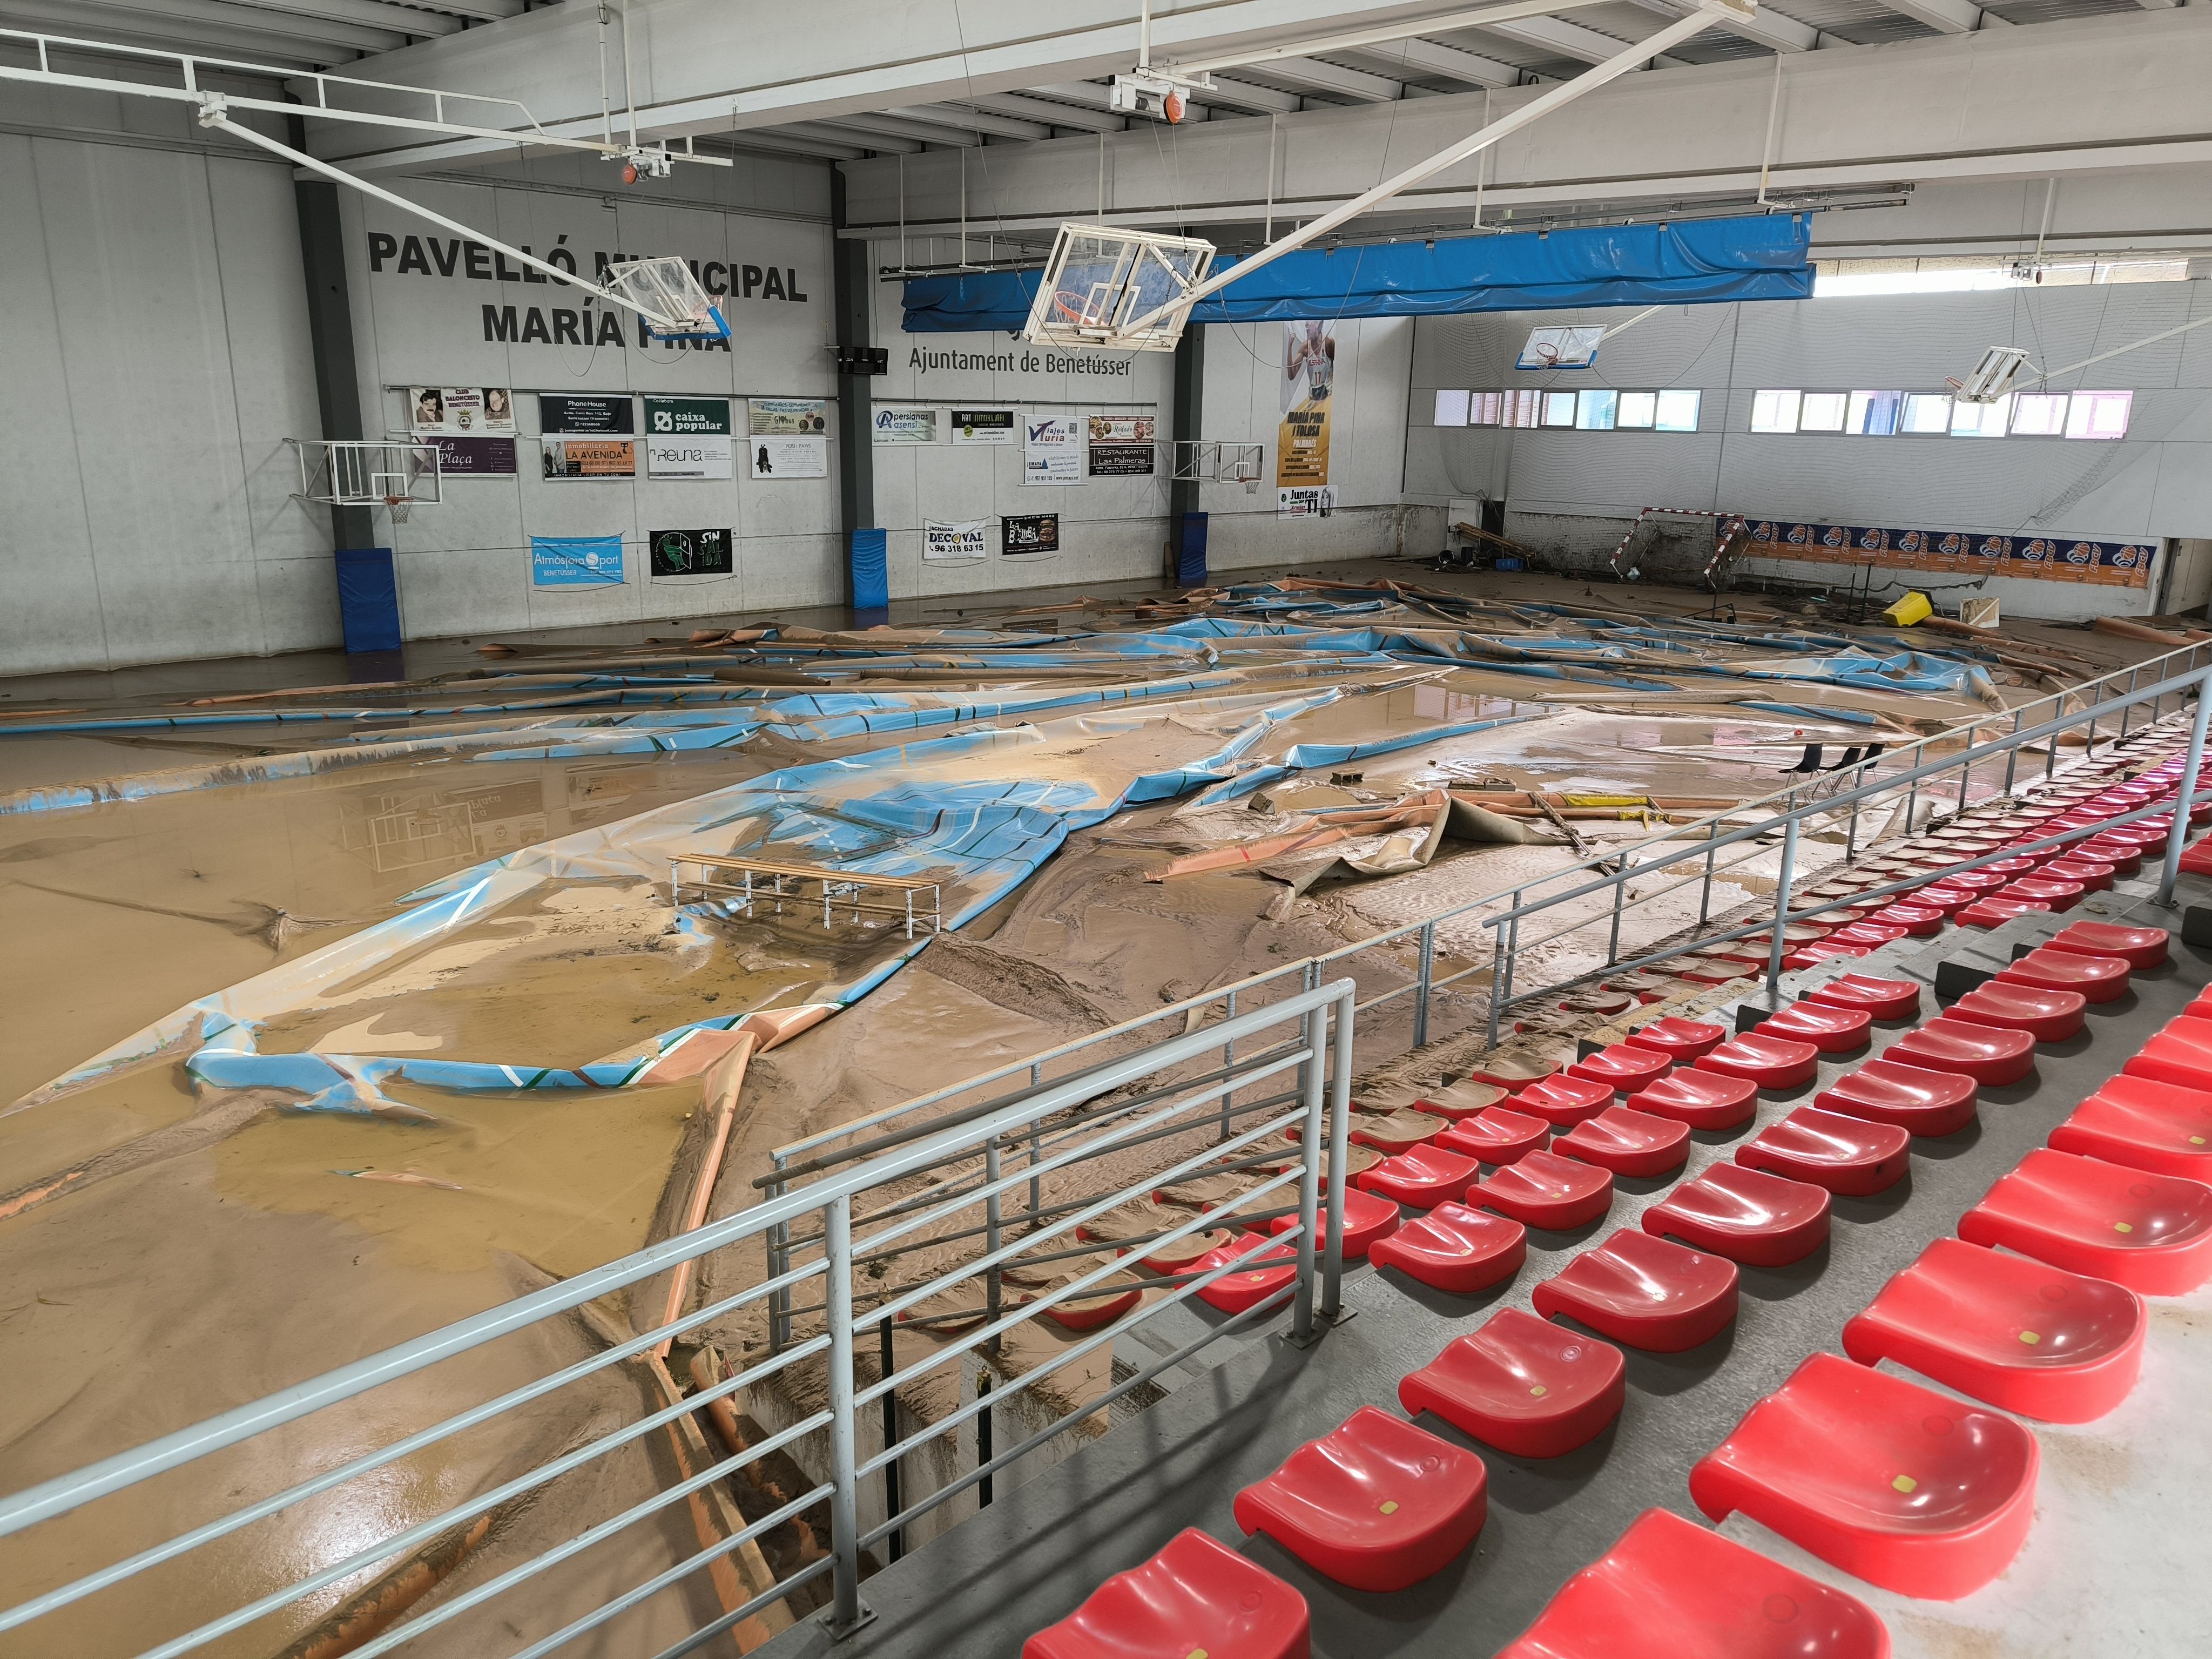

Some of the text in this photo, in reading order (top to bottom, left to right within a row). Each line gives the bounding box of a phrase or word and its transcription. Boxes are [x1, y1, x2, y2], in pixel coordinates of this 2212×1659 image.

[368, 232, 577, 286] PAVELLÓ
[482, 296, 625, 347] MARÍA
[909, 346, 1131, 376] Ajuntament de Benetússer
[675, 412, 705, 421] caixa
[894, 412, 928, 421] persianas
[1287, 410, 1325, 423] MARÍA PINA
[676, 421, 722, 431] popular
[1297, 425, 1320, 436] TOLOSA
[439, 440, 455, 451] La
[1293, 438, 1317, 448] PALMARÉS
[440, 451, 474, 467] Plaça
[566, 450, 623, 460] LA AVENIDA
[1114, 455, 1146, 464] Palmeras
[1290, 489, 1318, 500] Juntas
[1305, 499, 1318, 513] TI
[929, 532, 983, 544] DECOVAL
[1770, 523, 1779, 549] FBCV
[1805, 525, 1815, 552] FBCV
[1842, 527, 1852, 555] FBCV
[1879, 529, 1890, 557] FBCV
[1919, 531, 1929, 560] FBCV
[1959, 534, 1970, 563] FBCV
[2000, 536, 2012, 566] FBCV
[534, 552, 585, 569] Atmósfera
[2044, 540, 2056, 570] FBCV
[2089, 543, 2101, 574] FBCV
[2135, 547, 2149, 578] FBCV
